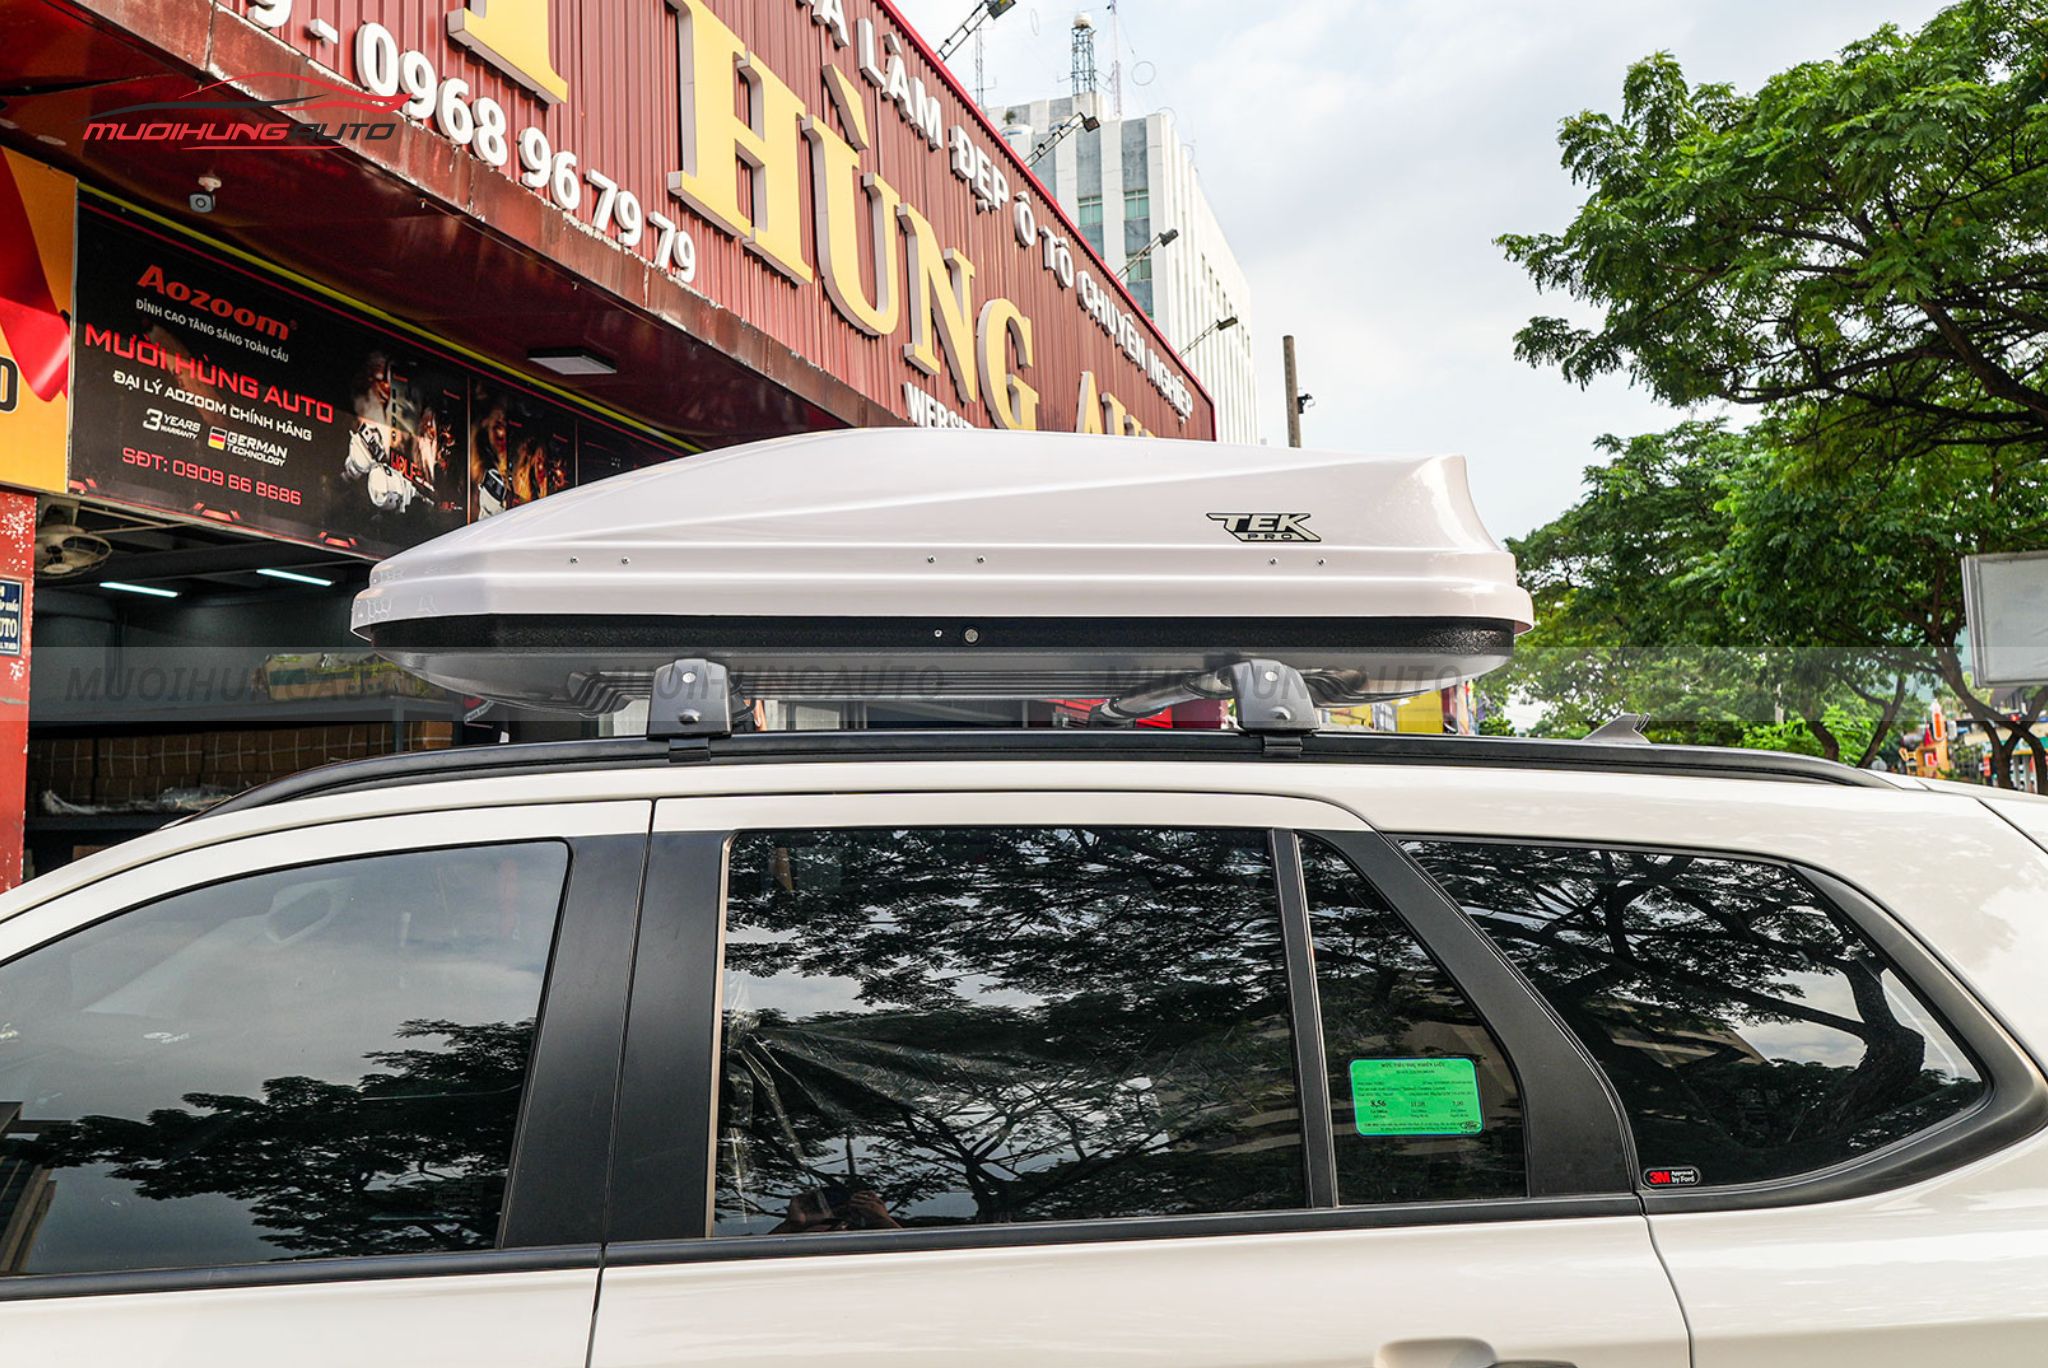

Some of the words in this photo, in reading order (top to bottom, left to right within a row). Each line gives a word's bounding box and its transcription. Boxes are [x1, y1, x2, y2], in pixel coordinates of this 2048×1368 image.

[356, 22, 508, 167] 0968
[518, 126, 581, 211] 96
[585, 168, 643, 247] 79
[648, 211, 696, 283] 79
[666, 0, 1040, 431] HÙNG
[857, 17, 943, 150] LÀM
[949, 124, 1010, 214] ĐẸP
[1014, 190, 1037, 248] Ô
[1038, 225, 1074, 289] TÔ
[1076, 270, 1146, 371] CHUYÊN
[1146, 348, 1194, 425] NGHIỆP
[136, 264, 290, 341] Aozoom
[164, 309, 186, 326] CAO
[216, 327, 243, 346] SÁNG
[244, 337, 270, 357] TOÀN
[84, 322, 168, 371] MƯỜI
[175, 354, 259, 399] HÙNG
[263, 385, 334, 424] AUTO
[112, 369, 140, 391] ĐẠI
[143, 378, 163, 395] LÝ
[164, 385, 227, 415] AOZOOM
[229, 408, 274, 430] CHÍNH
[276, 419, 312, 441] HÃNG
[142, 407, 163, 431] 3
[163, 414, 201, 433] YEARS
[160, 425, 198, 441] WARRANTY
[226, 431, 288, 459] GERMAN
[226, 442, 286, 467] TECHNOLOGY
[122, 446, 169, 473] SĐT:
[172, 460, 225, 486] 0909
[228, 474, 252, 493] 66
[255, 482, 302, 506] 8686
[1206, 513, 1321, 541] TEK
[1247, 532, 1292, 541] PRO
[1649, 1170, 1671, 1184] 3M
